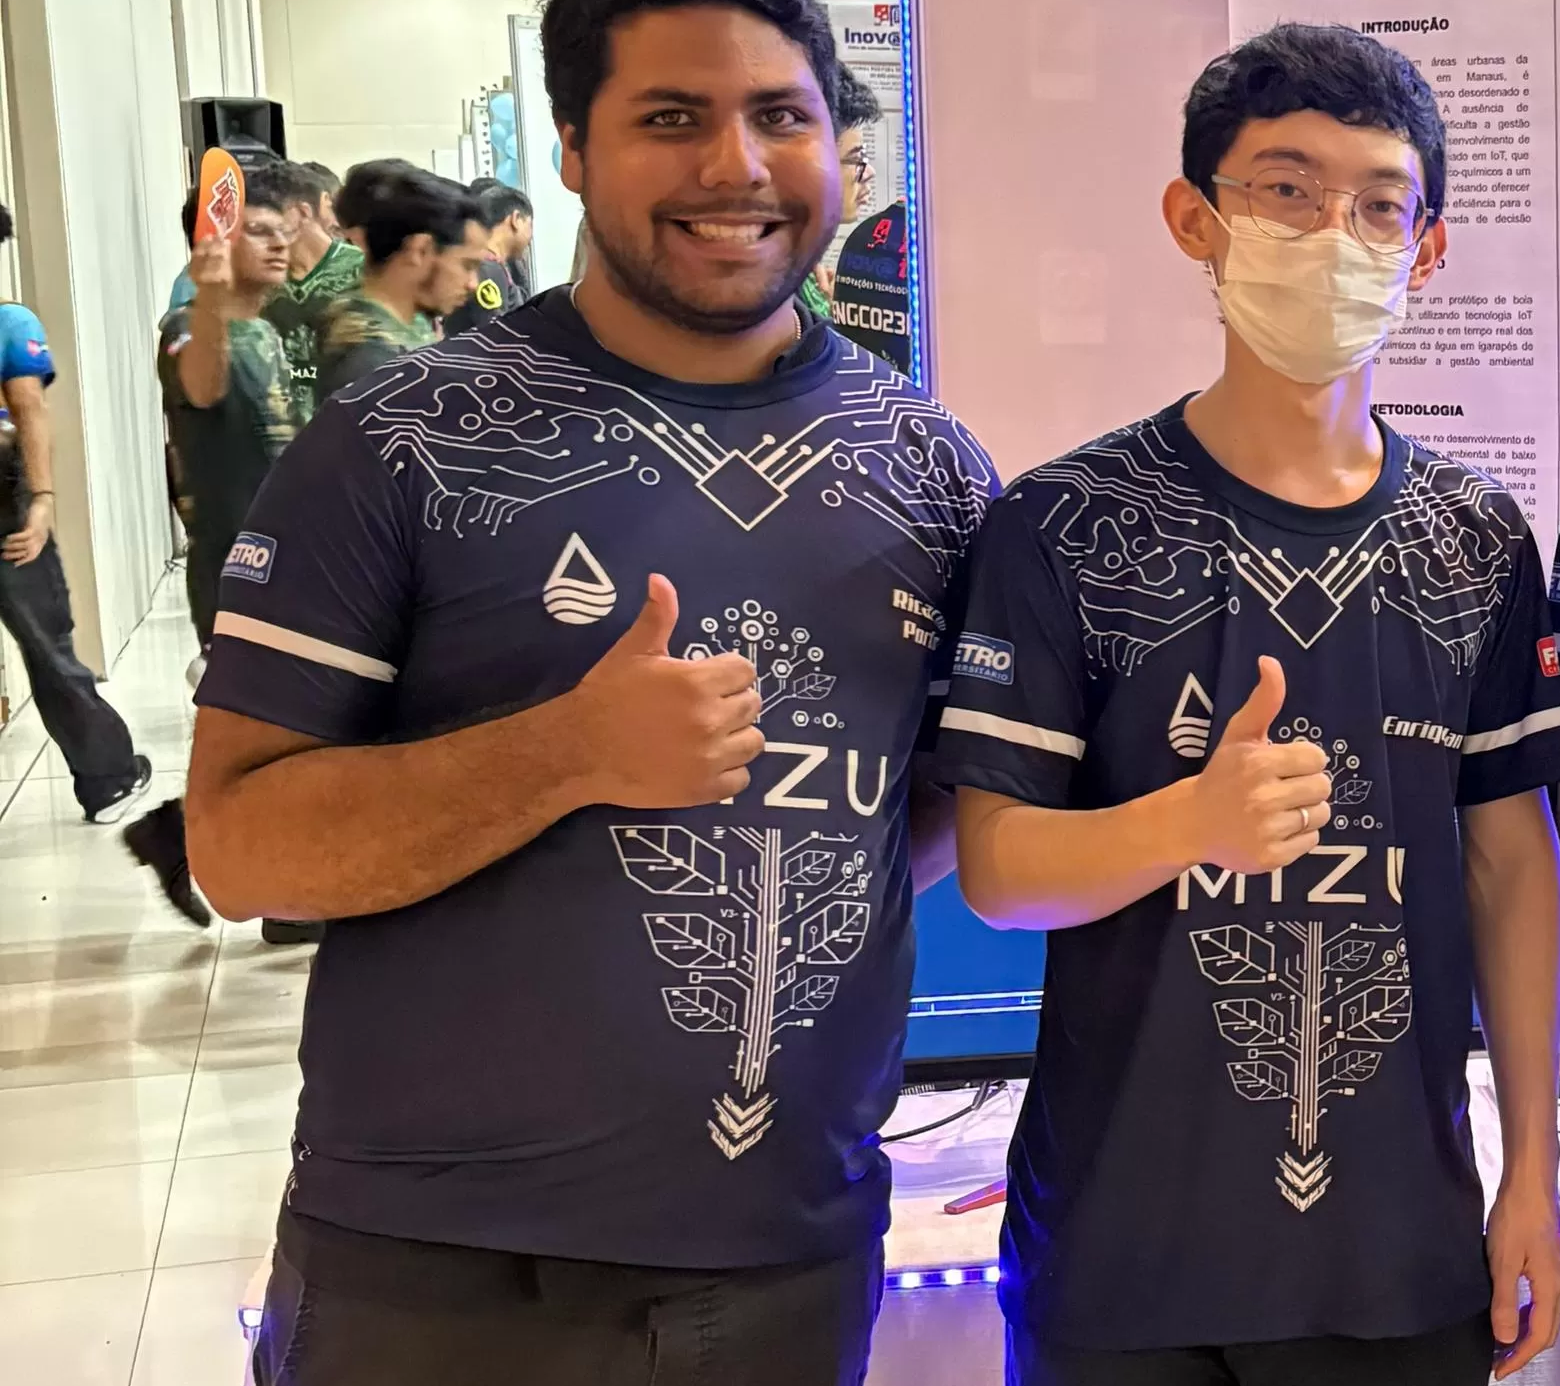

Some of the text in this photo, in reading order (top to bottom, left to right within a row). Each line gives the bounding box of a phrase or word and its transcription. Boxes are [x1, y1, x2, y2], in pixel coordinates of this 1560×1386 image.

[1361, 17, 1449, 34] INTRODUÇÃO
[1431, 56, 1505, 67] áreas urbanas
[1458, 88, 1519, 98] desordenado
[1462, 104, 1504, 113] ausência
[1498, 119, 1530, 130] gestão
[1452, 182, 1530, 192] visando oferecer
[1453, 198, 1495, 208] eficiência
[1495, 214, 1531, 224] decisão
